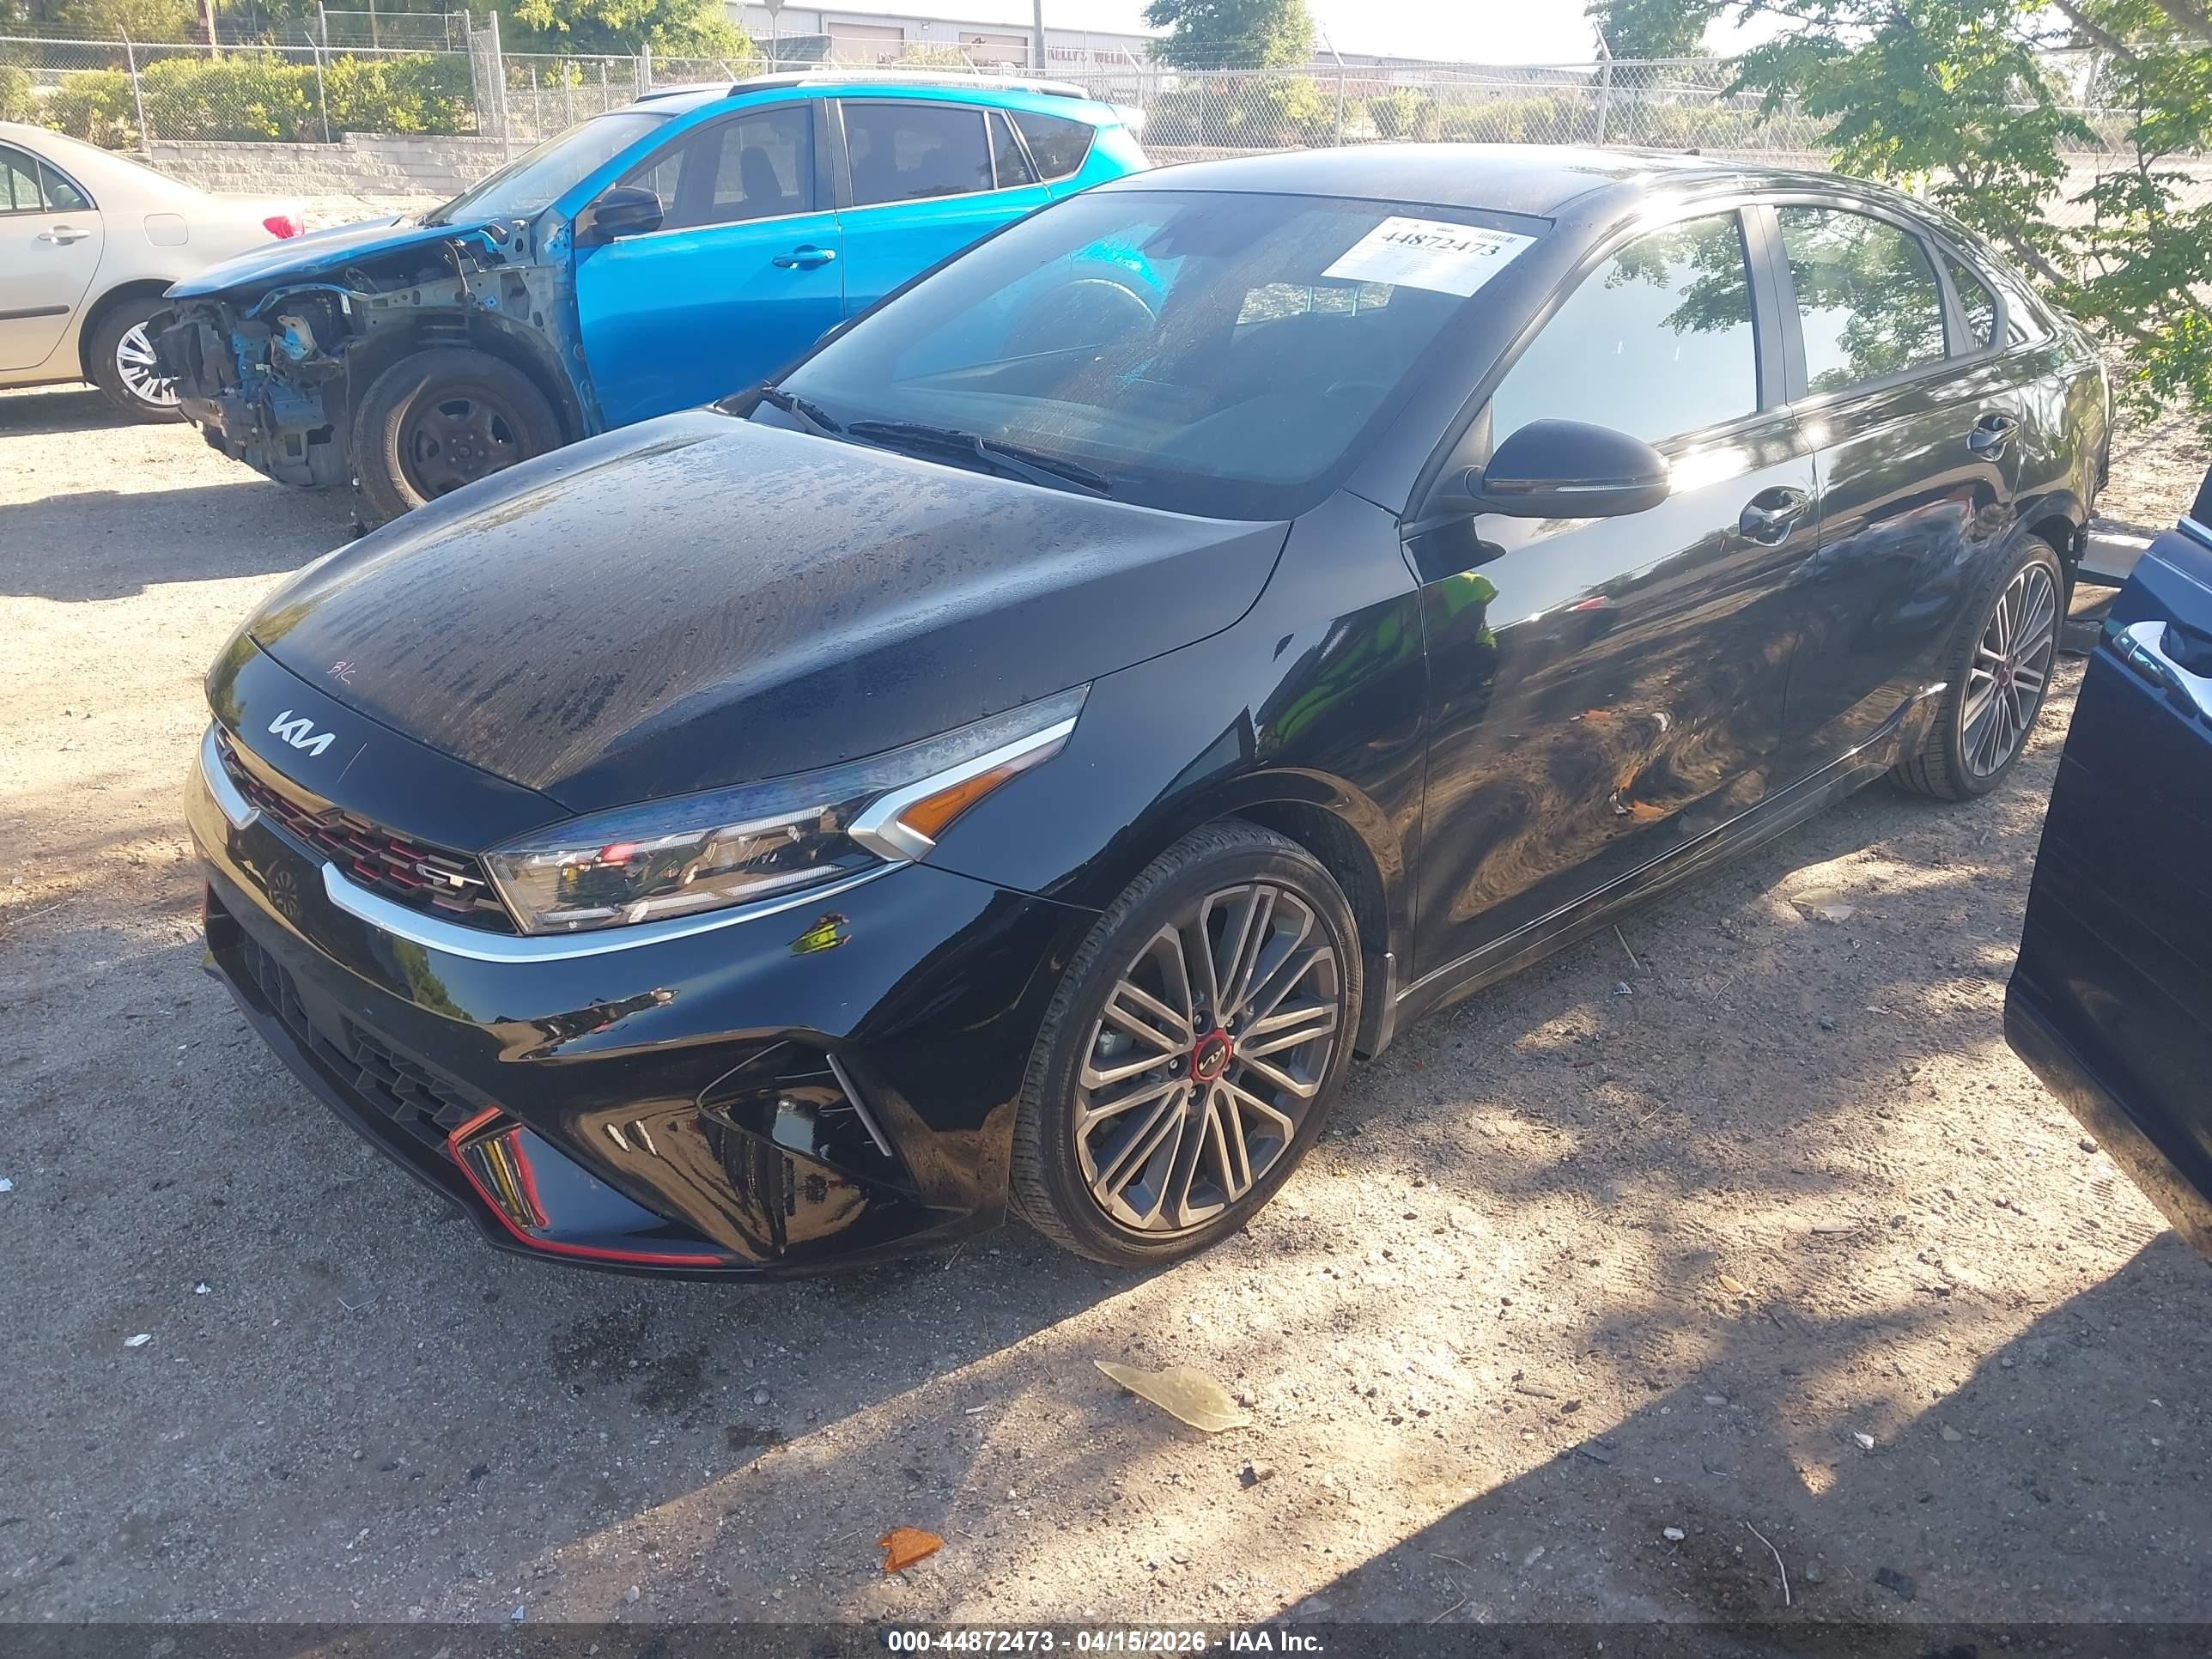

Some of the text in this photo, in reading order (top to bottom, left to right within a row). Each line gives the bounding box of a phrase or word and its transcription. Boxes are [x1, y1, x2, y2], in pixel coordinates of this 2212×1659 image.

[1382, 231, 1501, 257] 44872473
[267, 709, 337, 757] KIA
[416, 863, 485, 888] GT
